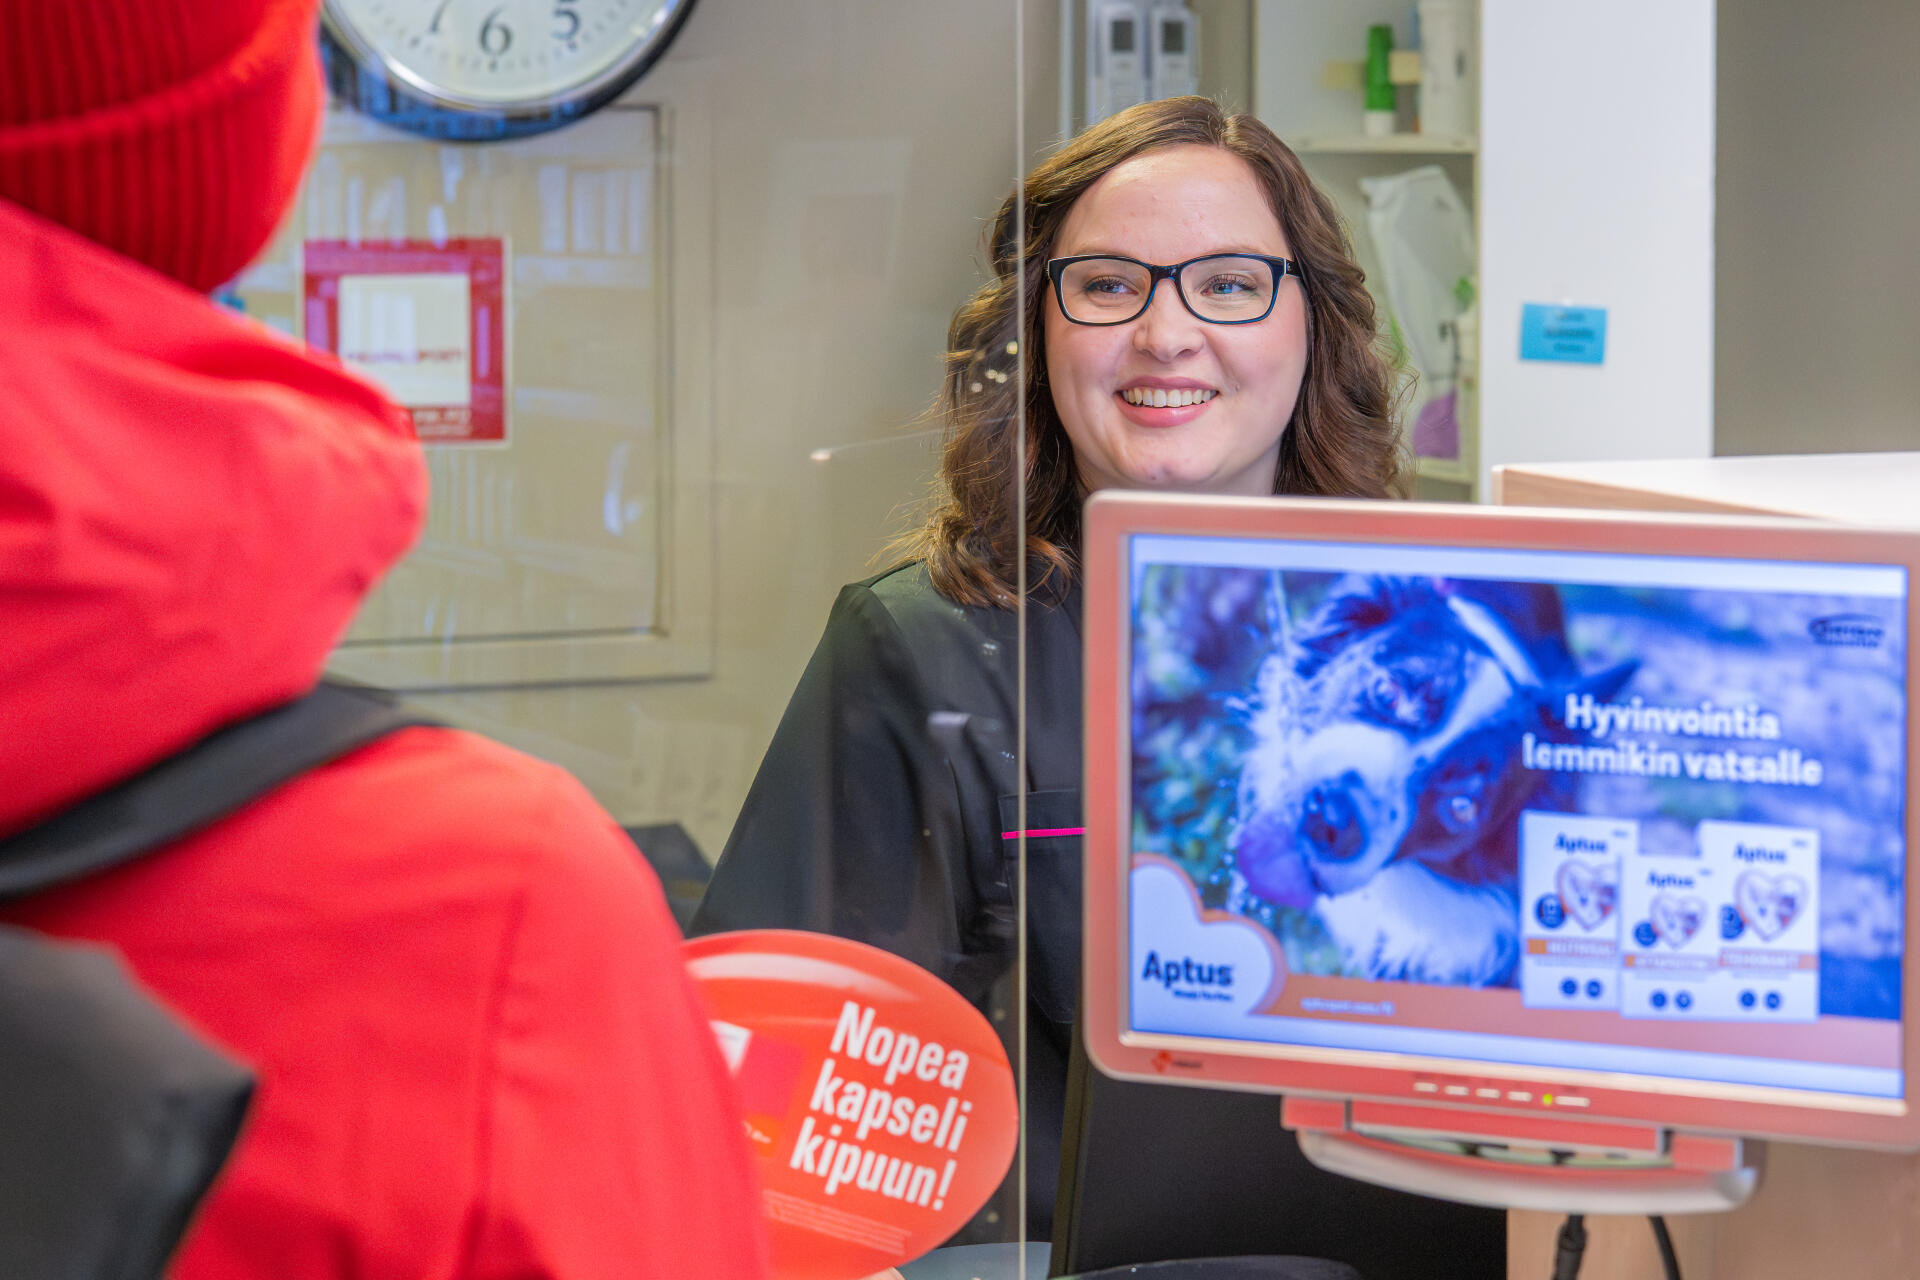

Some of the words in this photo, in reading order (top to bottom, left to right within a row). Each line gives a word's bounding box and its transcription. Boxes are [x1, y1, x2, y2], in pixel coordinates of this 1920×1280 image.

[478, 5, 513, 56] 6
[551, 0, 581, 40] 5
[1565, 692, 1780, 740] Hyvinvointia
[1522, 732, 1681, 775] lemmikin
[1683, 748, 1824, 787] vatsalle
[1142, 949, 1234, 989] Aptus
[829, 1000, 970, 1091] Nopea
[809, 1058, 974, 1153] kapseli
[789, 1116, 957, 1211] kipuun!
